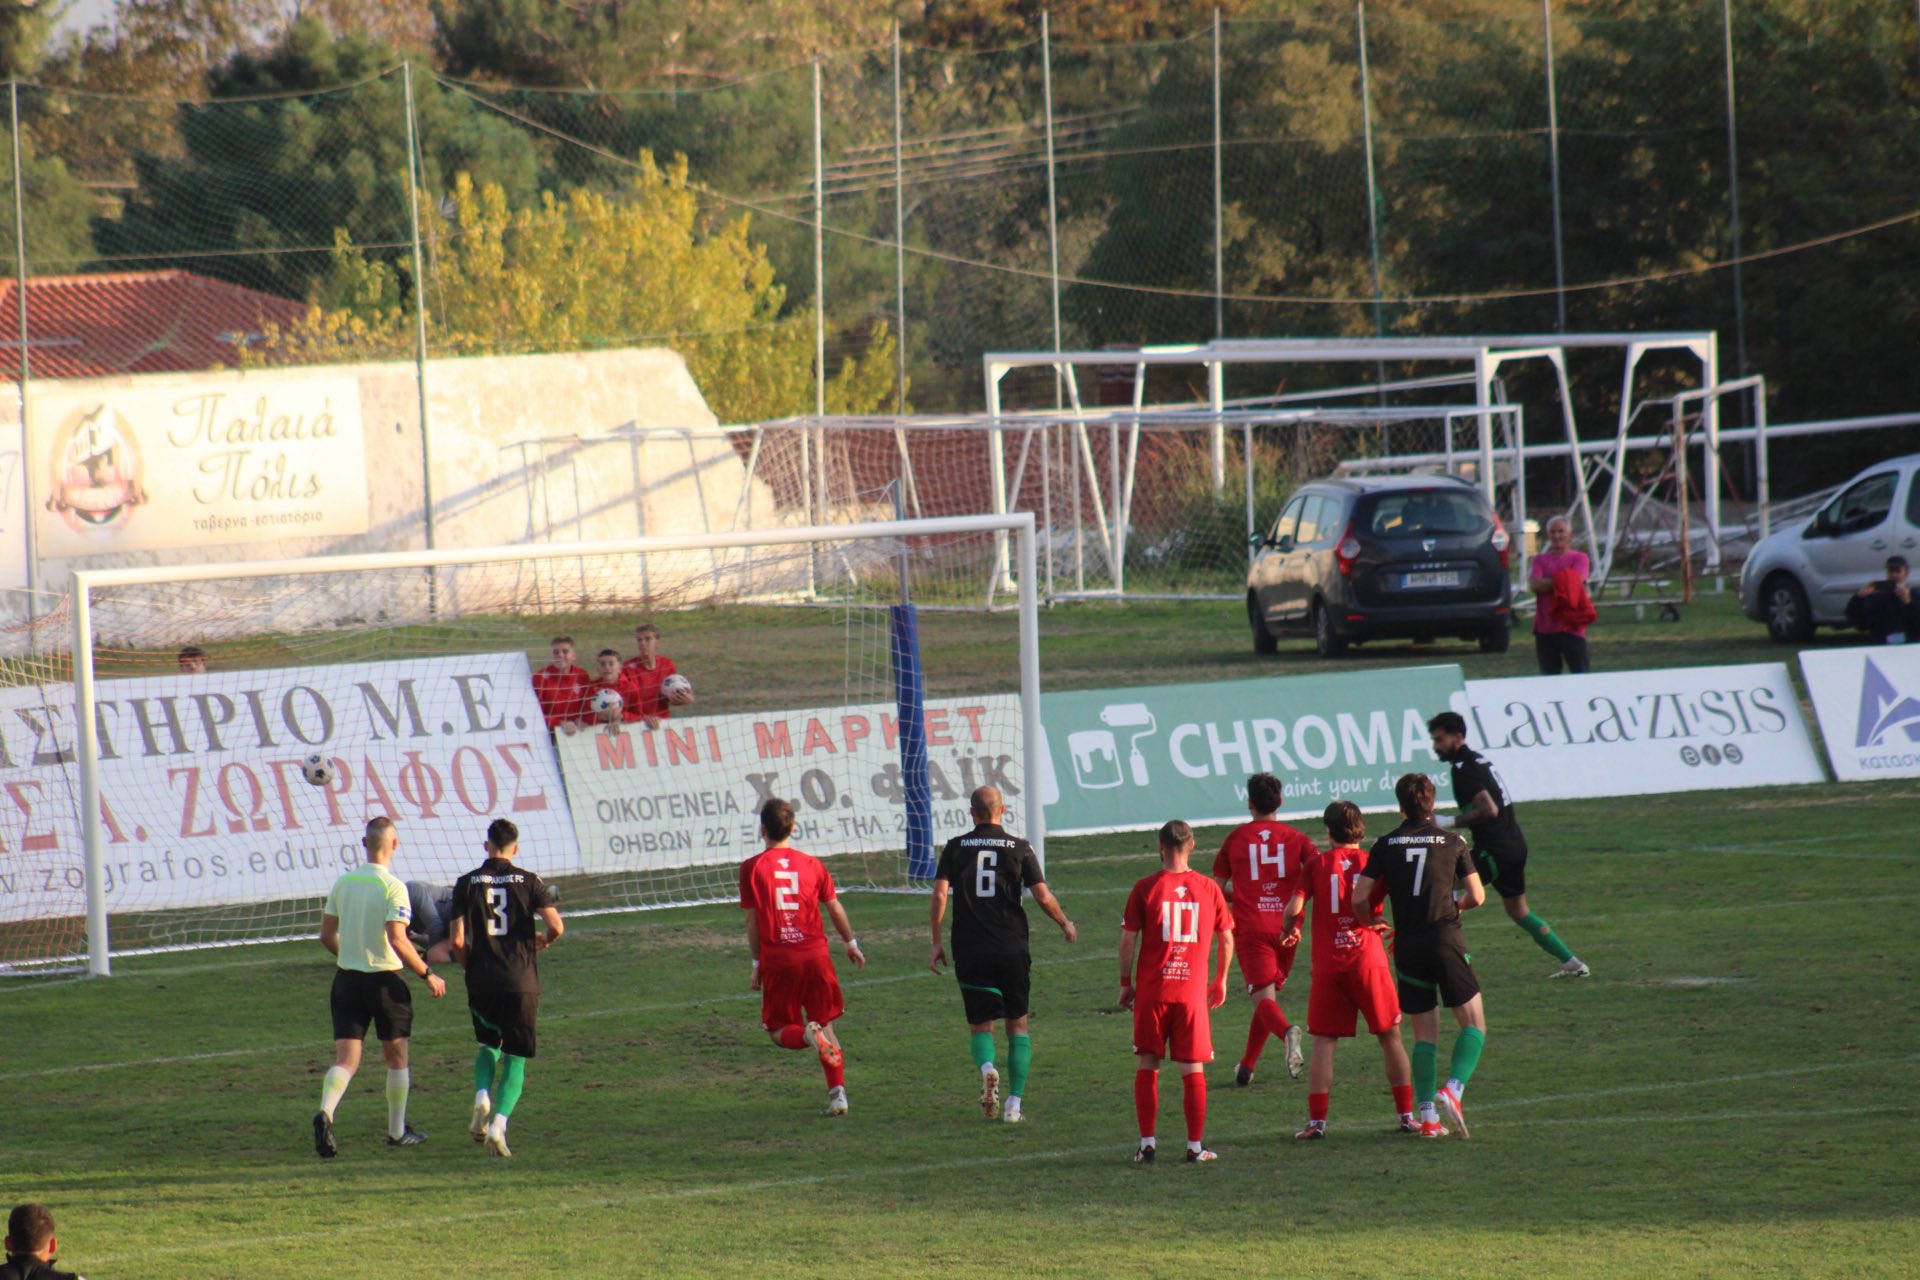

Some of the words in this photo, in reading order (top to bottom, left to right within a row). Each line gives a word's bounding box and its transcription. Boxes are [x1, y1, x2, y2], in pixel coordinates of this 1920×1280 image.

[167, 393, 337, 448] Παλαιά
[1169, 708, 1435, 778] CHROMA
[596, 790, 740, 824] ΟΙΚΟΓΕΝΕΙΑ
[1282, 777, 1322, 798] aint
[1329, 779, 1373, 800] your
[703, 826, 729, 848] 22
[1435, 836, 1445, 844] FC
[976, 850, 997, 897] 6
[1249, 843, 1286, 880] 14
[1405, 848, 1428, 896] 7
[774, 871, 800, 910] 2
[487, 888, 508, 936] 3
[1162, 901, 1199, 942] 10
